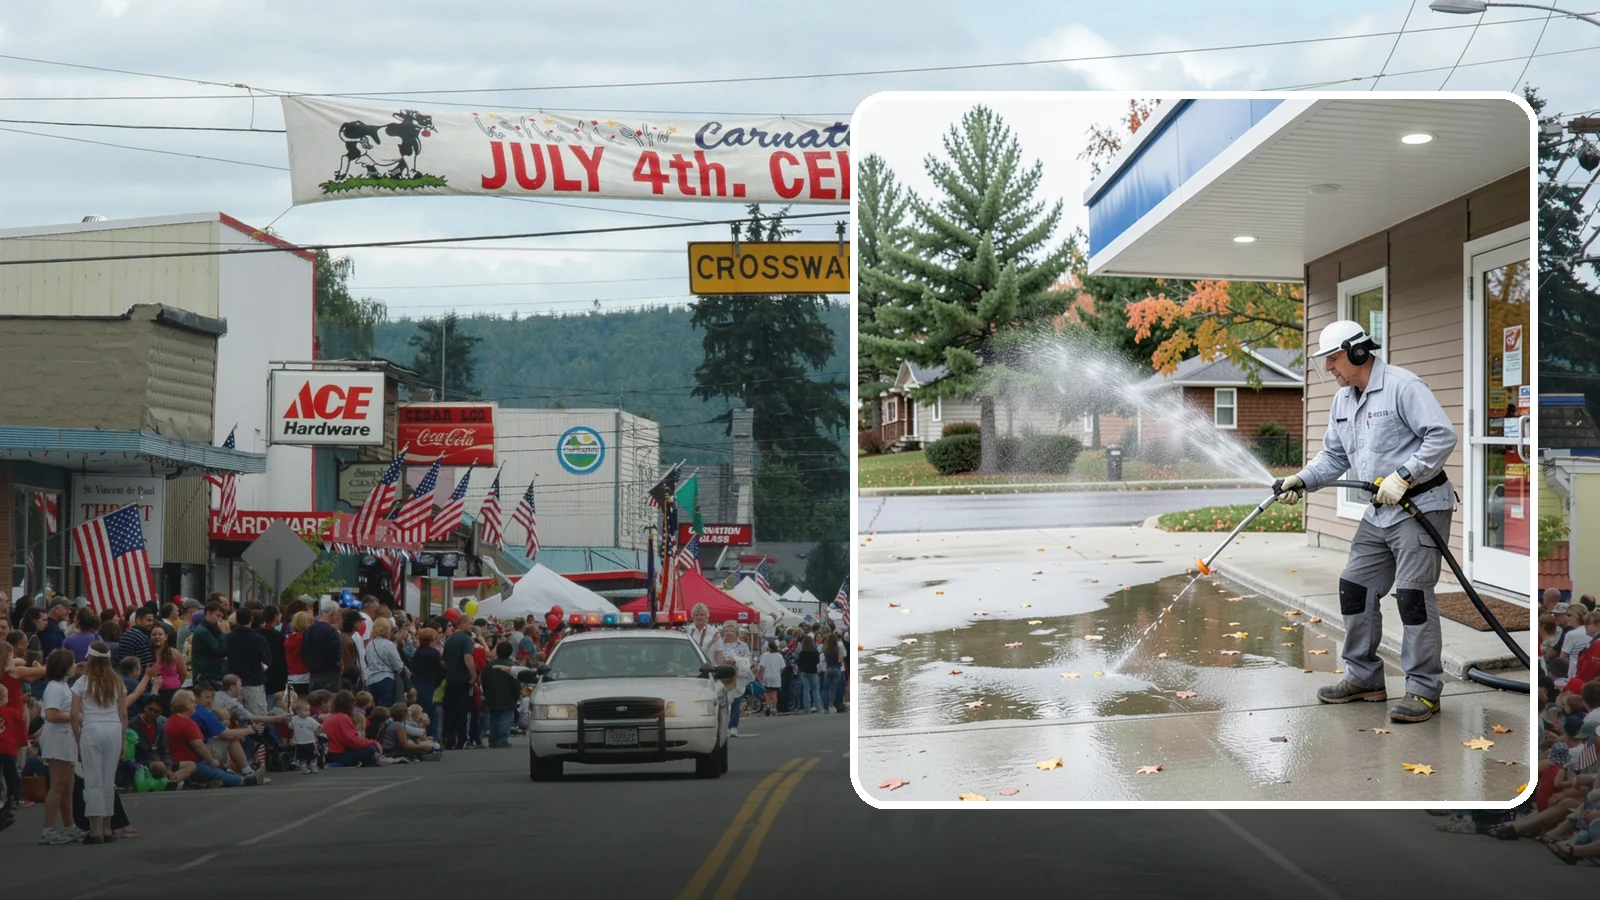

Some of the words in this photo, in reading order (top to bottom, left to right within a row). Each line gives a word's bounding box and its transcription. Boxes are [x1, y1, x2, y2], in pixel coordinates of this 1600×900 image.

[694, 121, 850, 149] Carnat
[481, 141, 605, 192] JULY
[632, 150, 746, 197] 4th.
[697, 254, 850, 280] CROSSWA
[282, 380, 373, 420] ACE
[405, 409, 452, 422] CEDAR
[461, 409, 485, 421] LOG
[283, 421, 371, 437] Hardware
[353, 467, 386, 480] Simpl
[83, 485, 93, 495] St.
[95, 485, 124, 495] Vincent
[126, 486, 136, 495] de
[137, 486, 155, 496] Paul
[212, 515, 331, 535] HARDARE
[688, 526, 741, 535] CRNATION
[699, 535, 730, 543] GLASS
